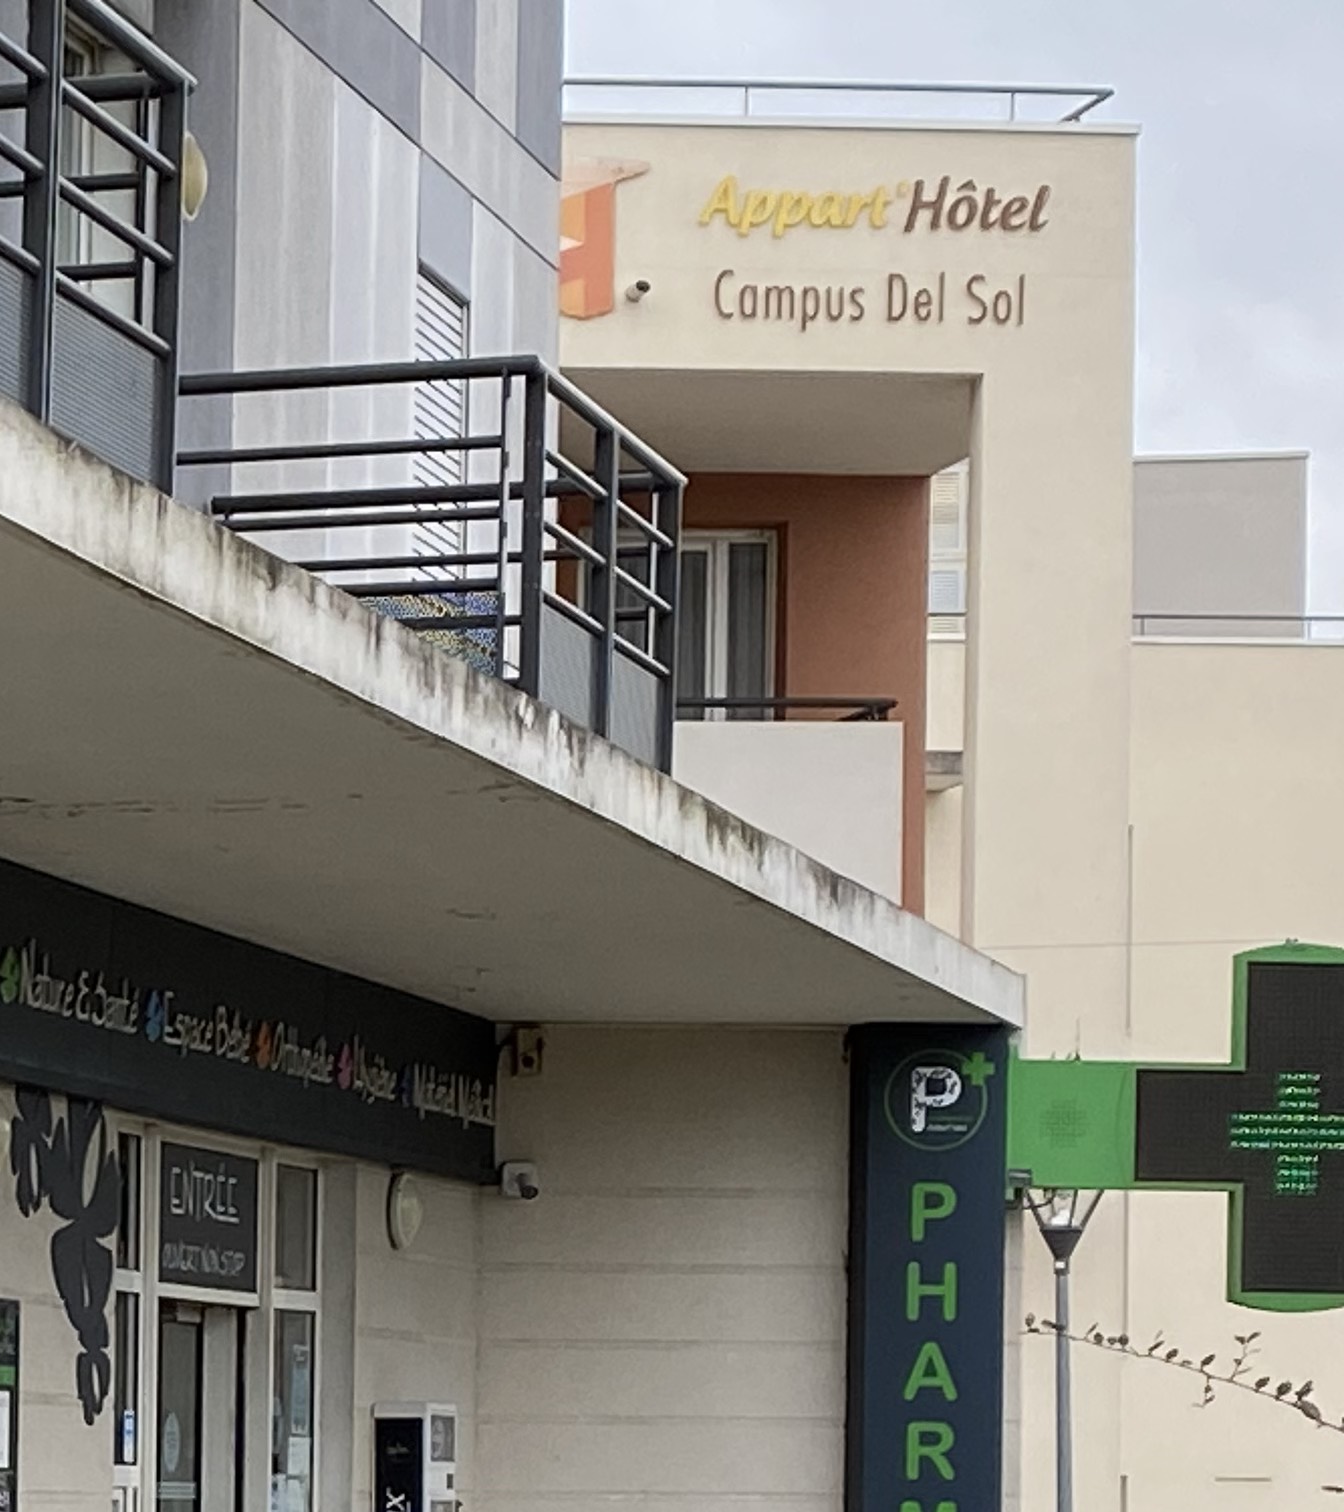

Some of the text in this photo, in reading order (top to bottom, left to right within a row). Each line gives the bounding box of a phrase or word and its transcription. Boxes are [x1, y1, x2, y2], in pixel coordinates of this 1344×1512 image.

[714, 269, 1026, 332] Campus Del Sol
[19, 937, 74, 1018] Nature
[163, 991, 213, 1059] Espace
[170, 1160, 240, 1224] ENTRÉE
